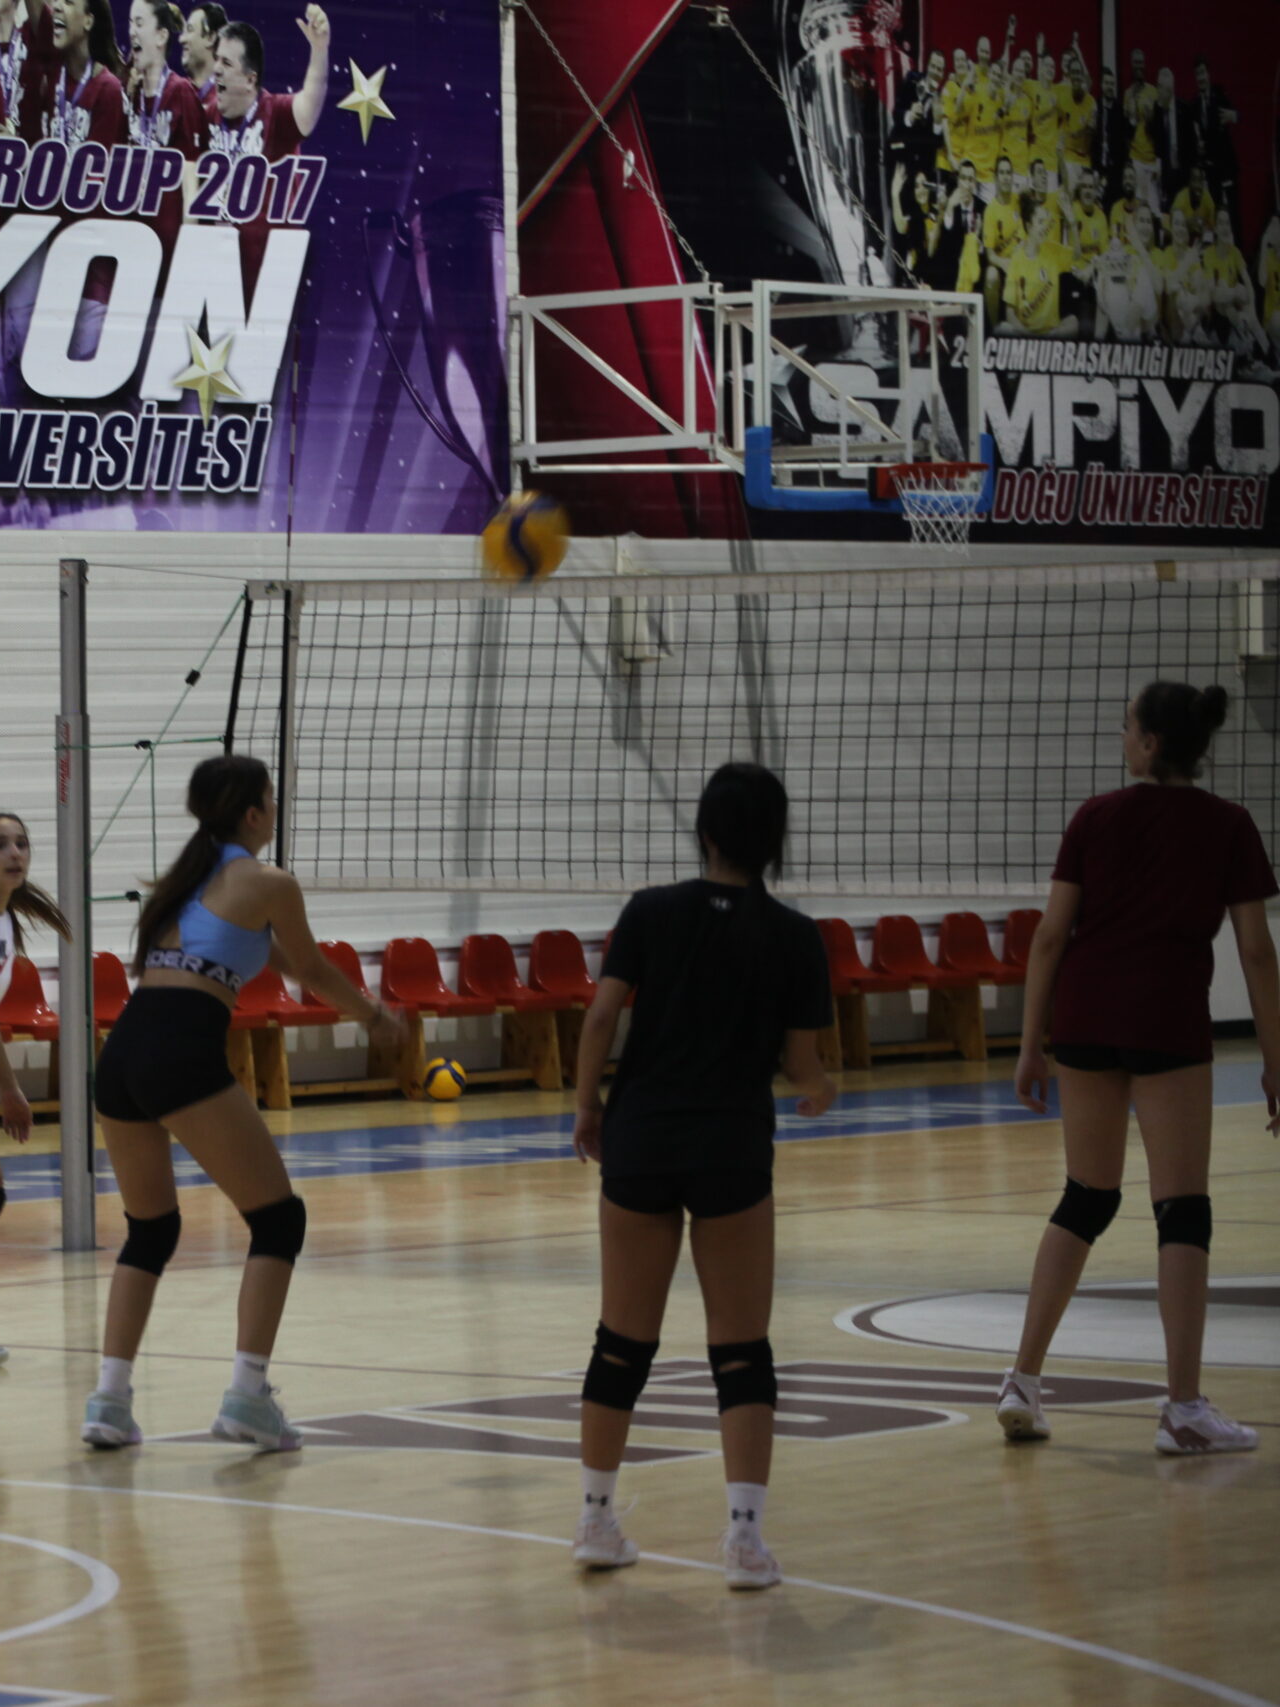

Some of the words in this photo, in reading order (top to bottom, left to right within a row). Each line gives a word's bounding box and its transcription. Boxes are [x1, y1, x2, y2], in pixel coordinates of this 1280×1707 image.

[188, 152, 327, 224] 2017
[983, 336, 1170, 382] CUMHURBAŞKANLIĞI
[1171, 347, 1234, 381] KUPASI
[992, 455, 1079, 525] DOĞU
[1079, 460, 1269, 528] ÜNİVERSİTESİ
